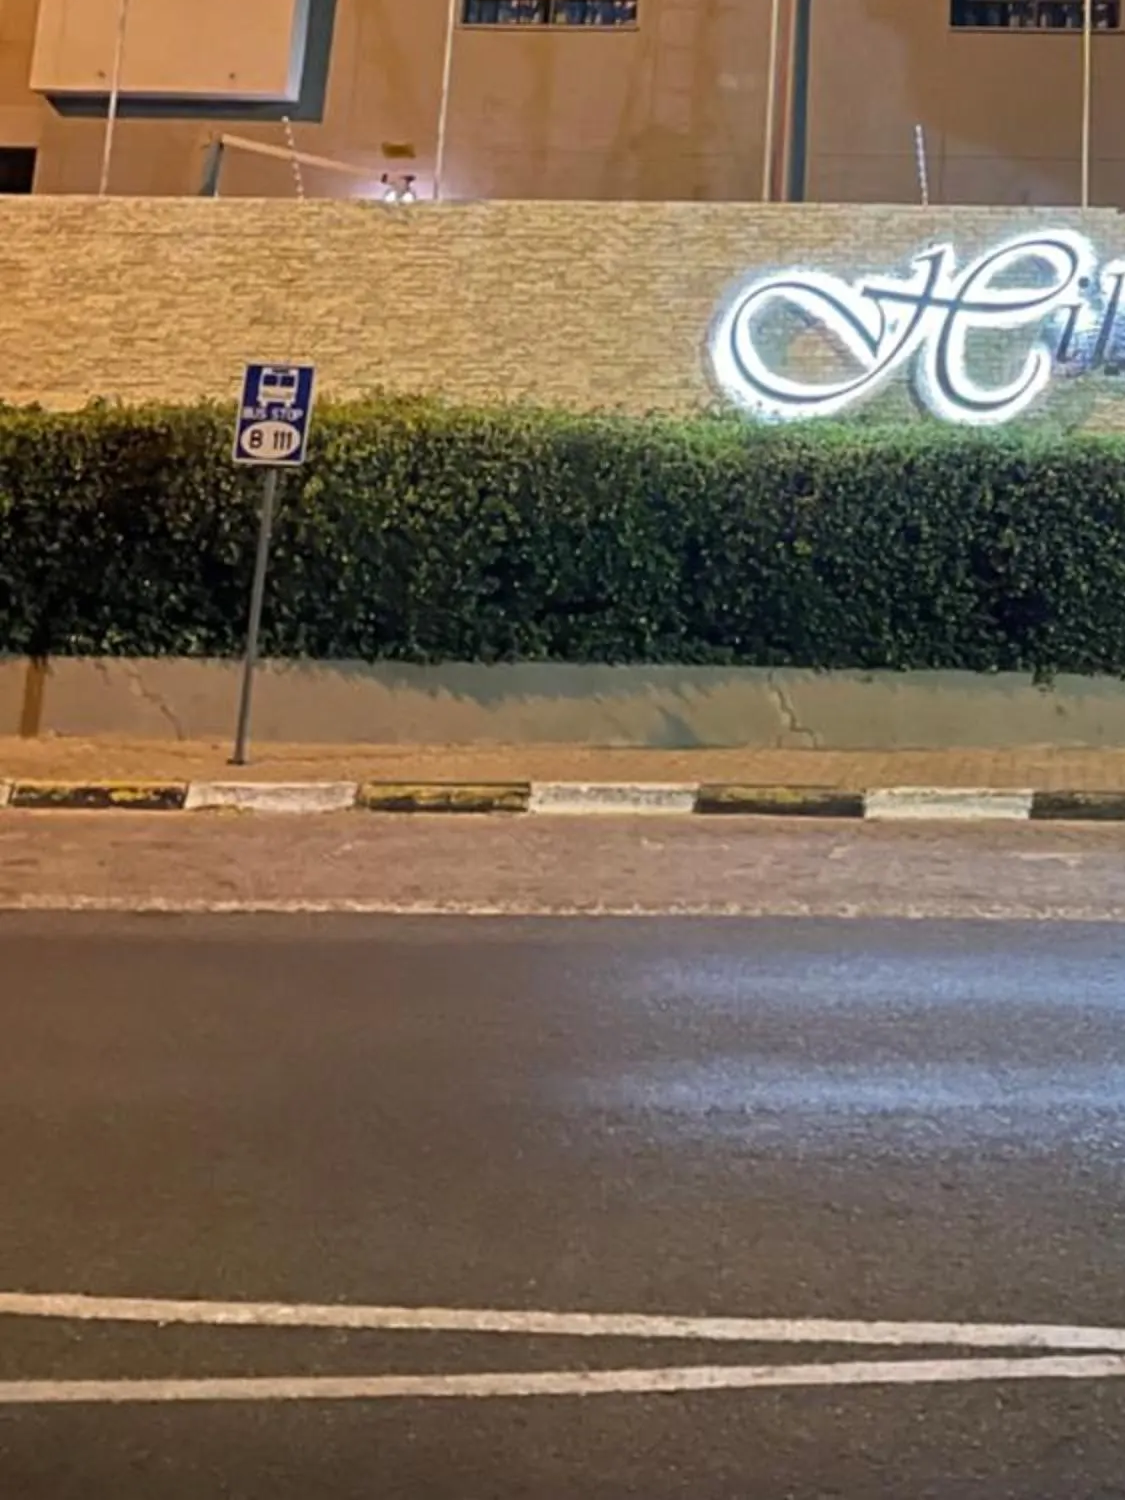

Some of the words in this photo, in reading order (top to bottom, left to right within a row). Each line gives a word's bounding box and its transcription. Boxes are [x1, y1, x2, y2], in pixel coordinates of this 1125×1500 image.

[242, 406, 267, 419] BUS
[271, 407, 304, 421] STOP
[273, 430, 293, 450] 111
